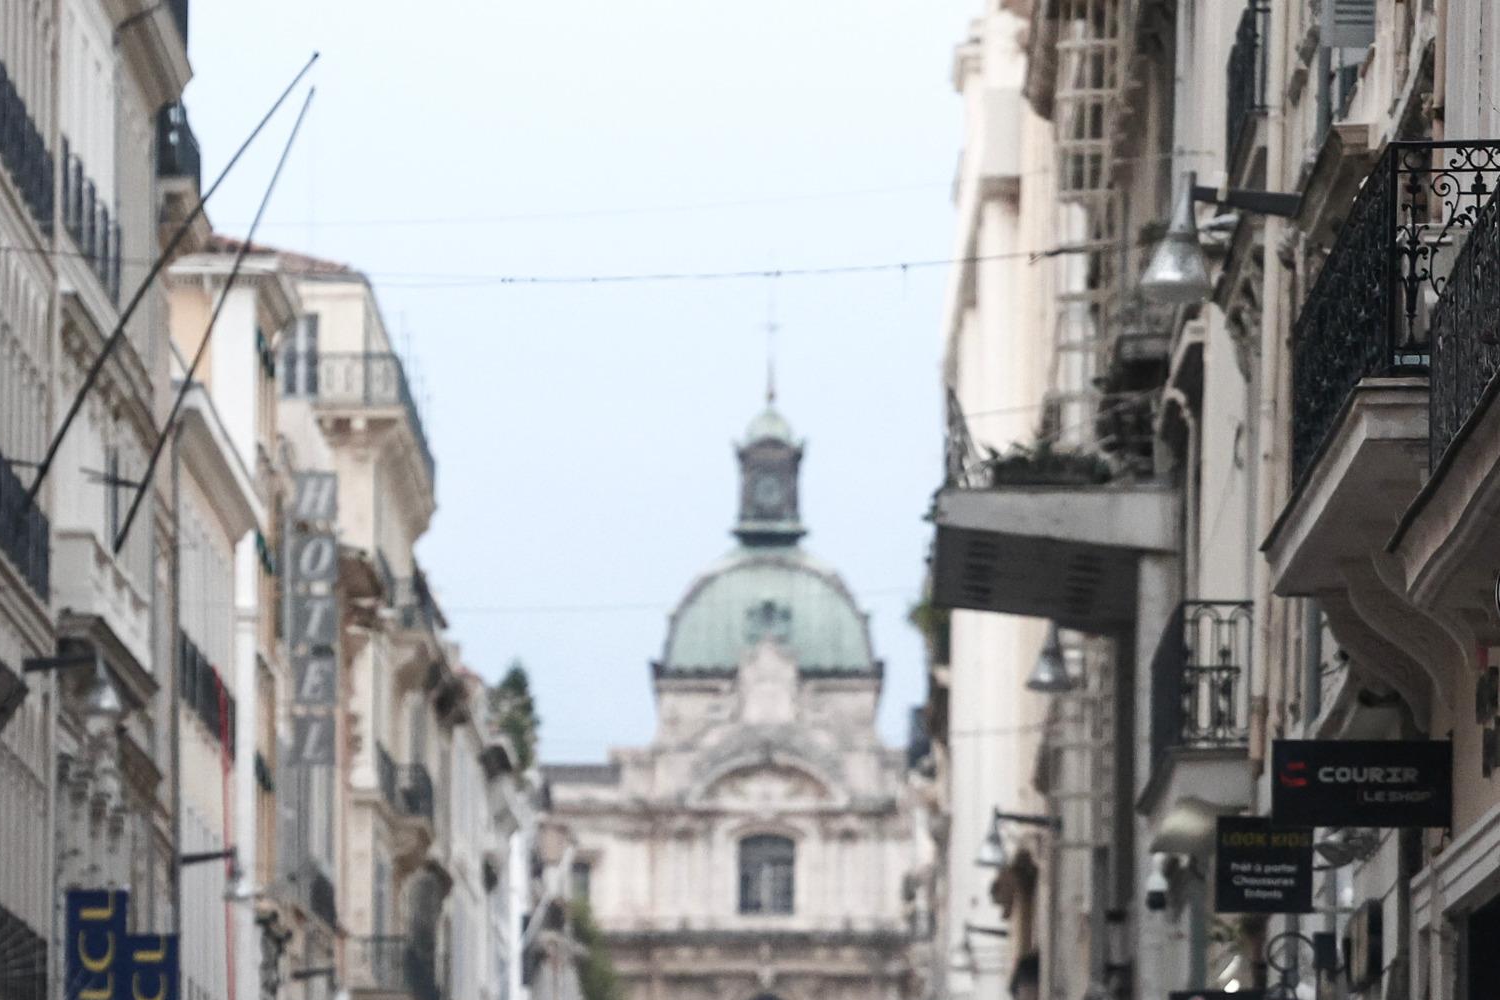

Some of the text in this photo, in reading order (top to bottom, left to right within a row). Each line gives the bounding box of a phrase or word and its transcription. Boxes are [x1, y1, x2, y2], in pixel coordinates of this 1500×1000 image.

[299, 475, 335, 760] HOTEL
[1318, 767, 1419, 783] COURIR
[1222, 832, 1267, 847] LOOK
[79, 888, 115, 1000] LCL
